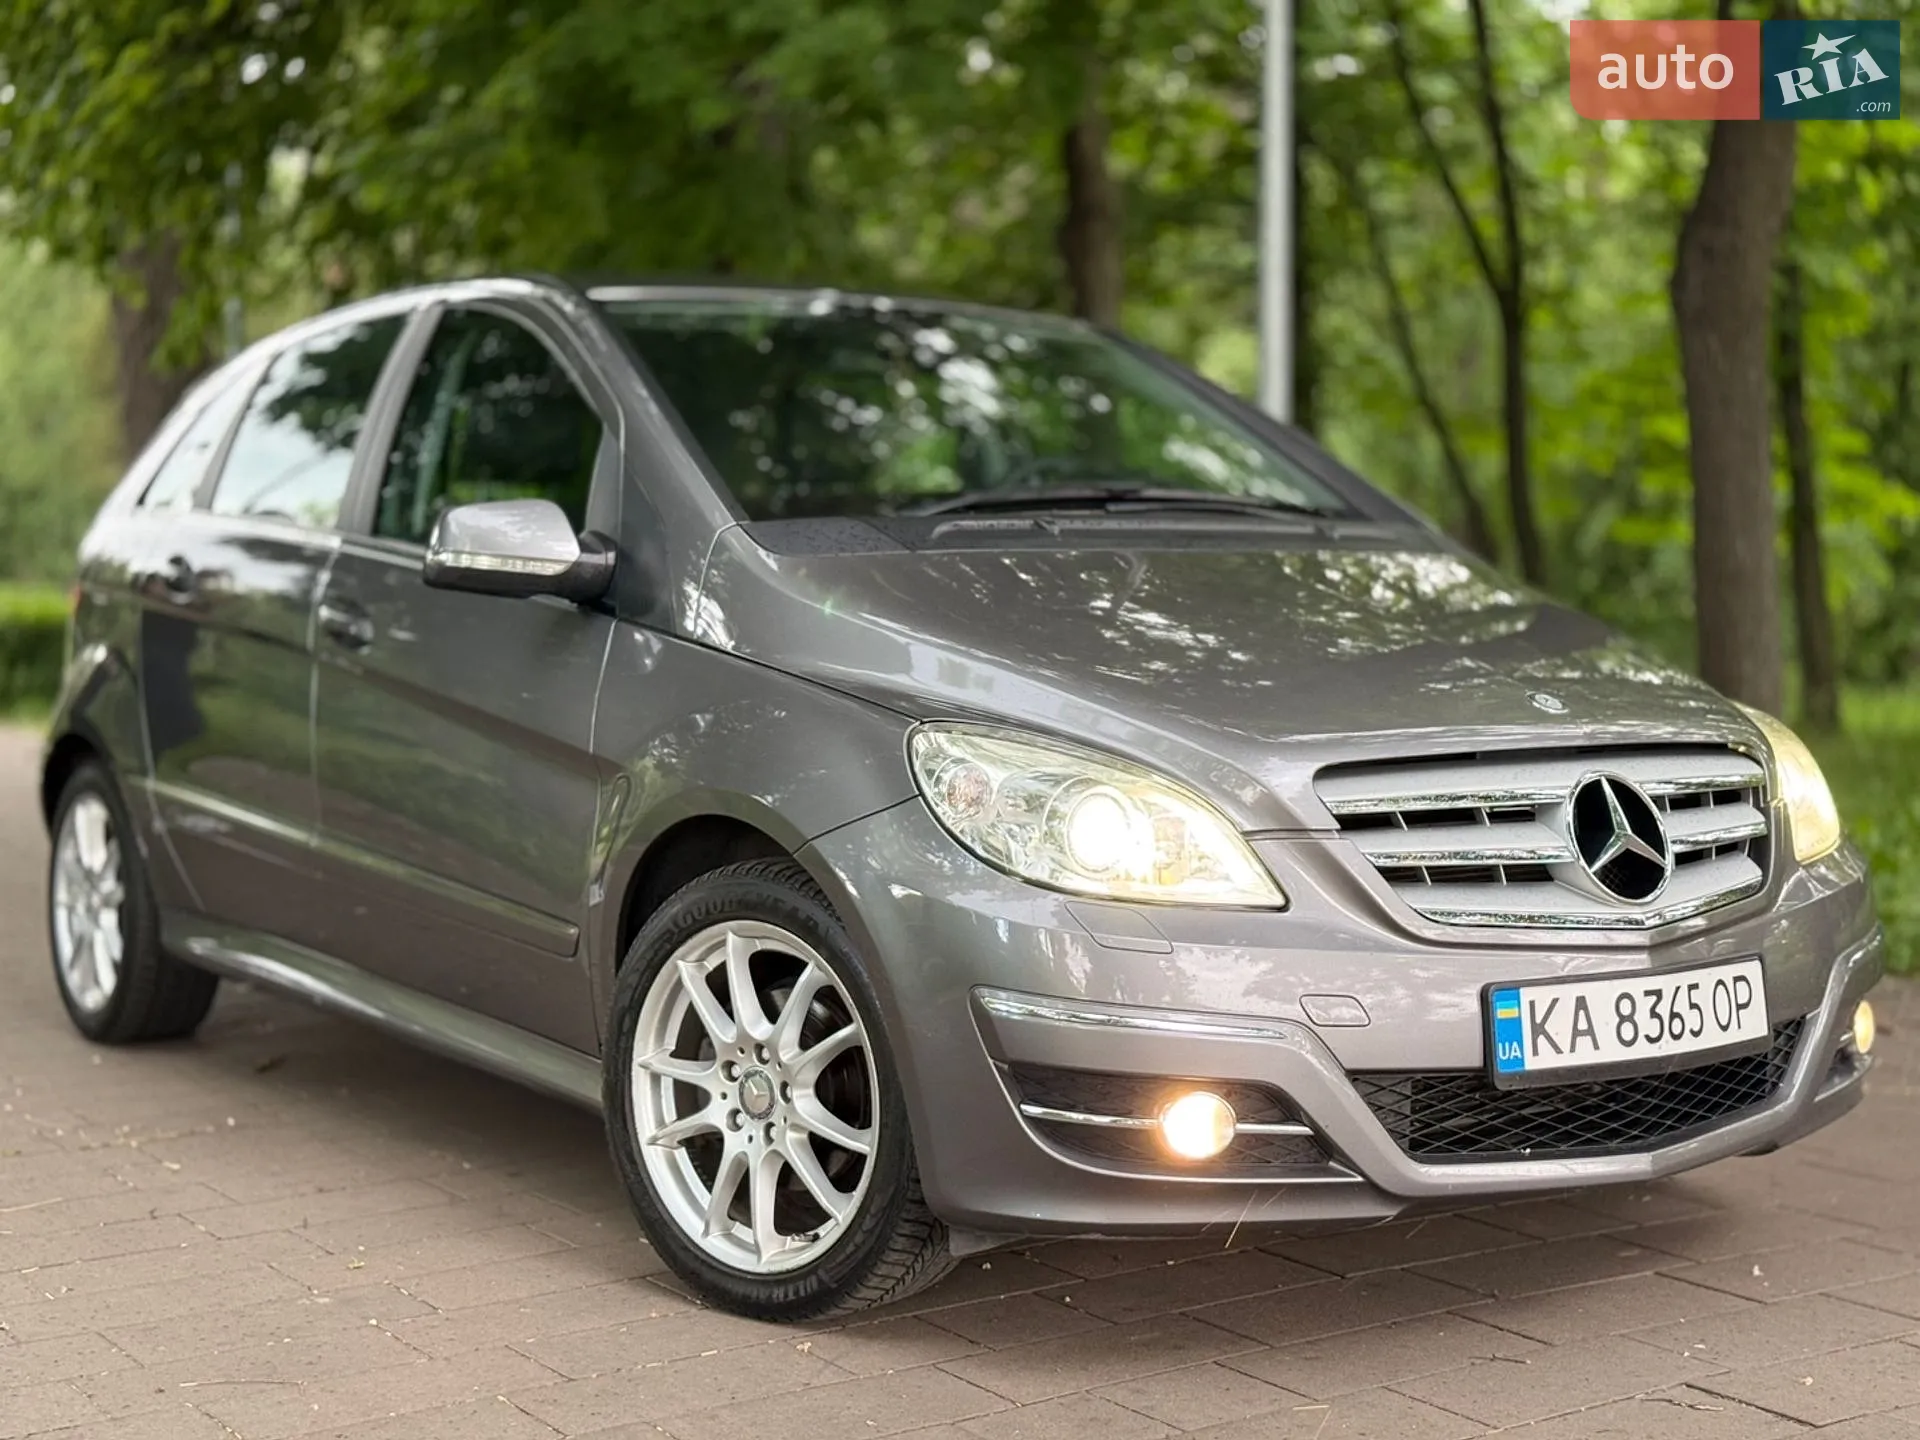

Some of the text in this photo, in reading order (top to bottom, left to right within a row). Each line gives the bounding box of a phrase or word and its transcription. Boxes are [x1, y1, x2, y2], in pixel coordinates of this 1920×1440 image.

[1528, 975, 1752, 1057] KA 8365 OP
[1499, 1042, 1522, 1060] UA
